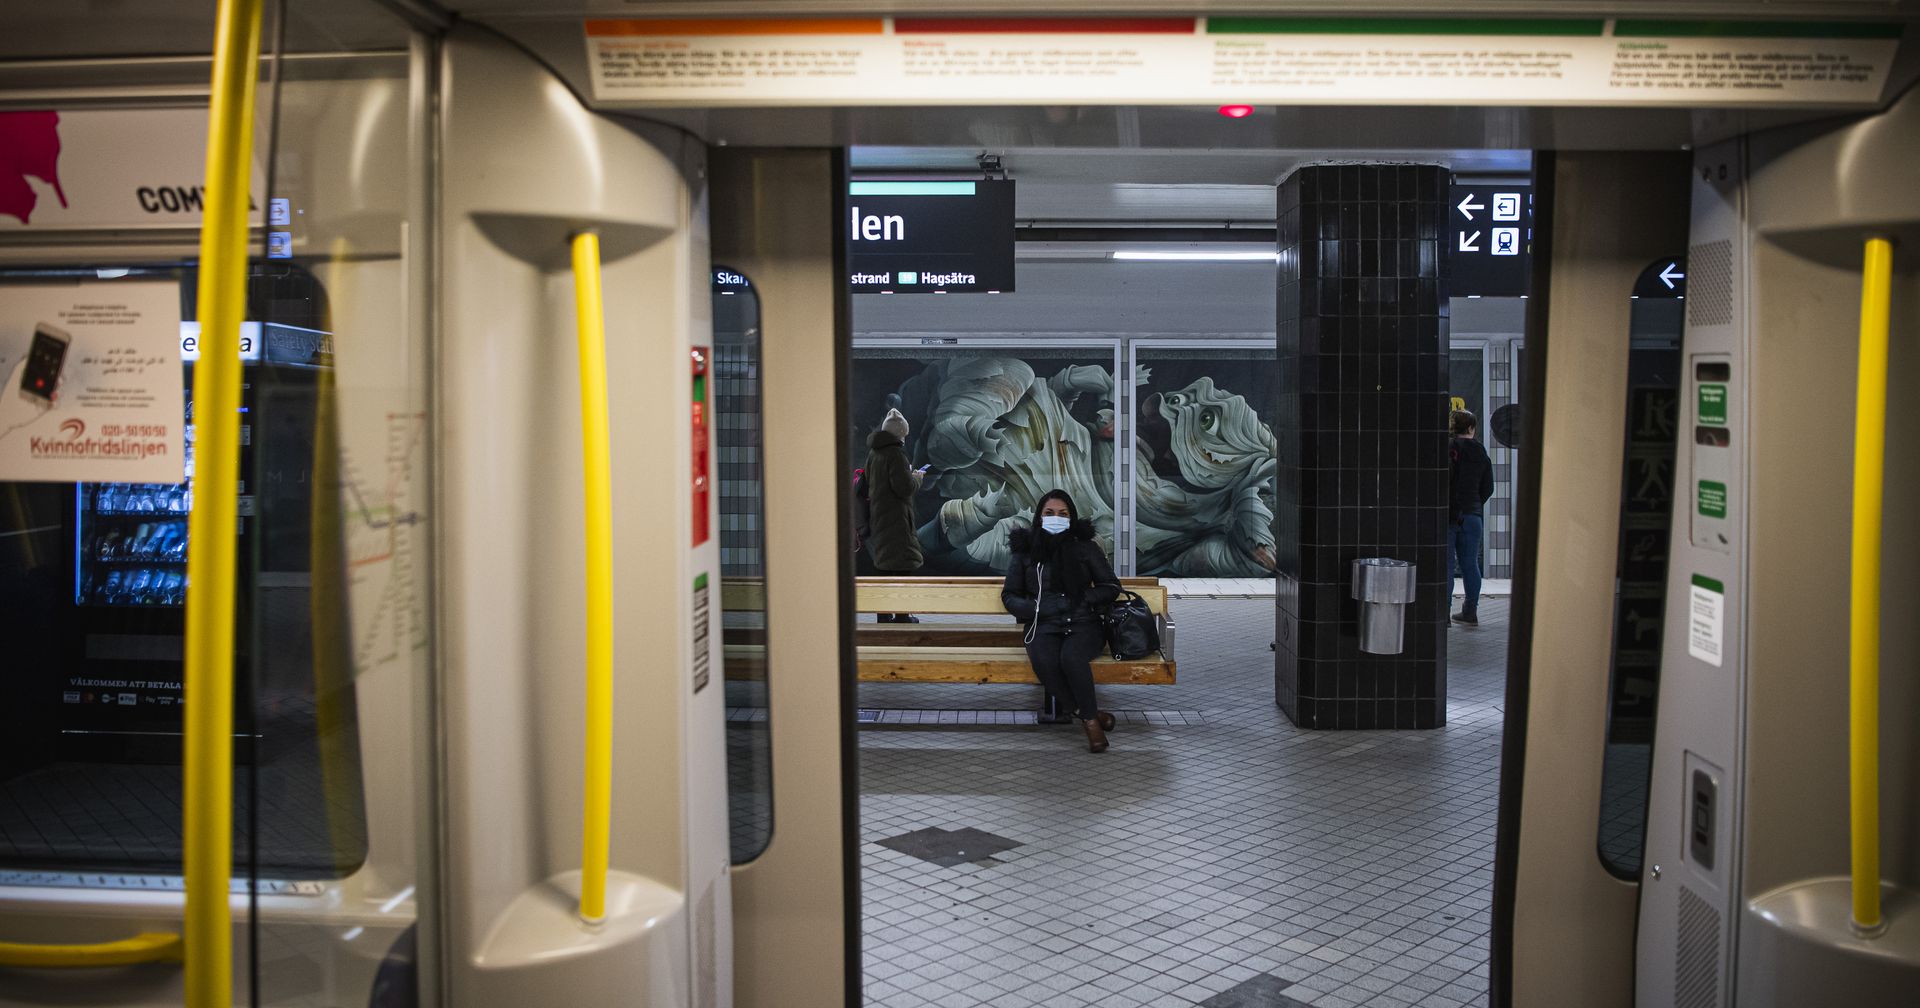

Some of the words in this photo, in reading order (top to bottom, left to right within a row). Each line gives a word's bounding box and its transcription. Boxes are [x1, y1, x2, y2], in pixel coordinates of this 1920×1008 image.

[851, 206, 905, 241] len
[851, 272, 890, 284] strand
[921, 272, 976, 287] Hagsätra
[30, 436, 168, 459] Kvinnofridslinjen
[129, 680, 146, 689] ATT
[147, 680, 182, 690] BETALA
